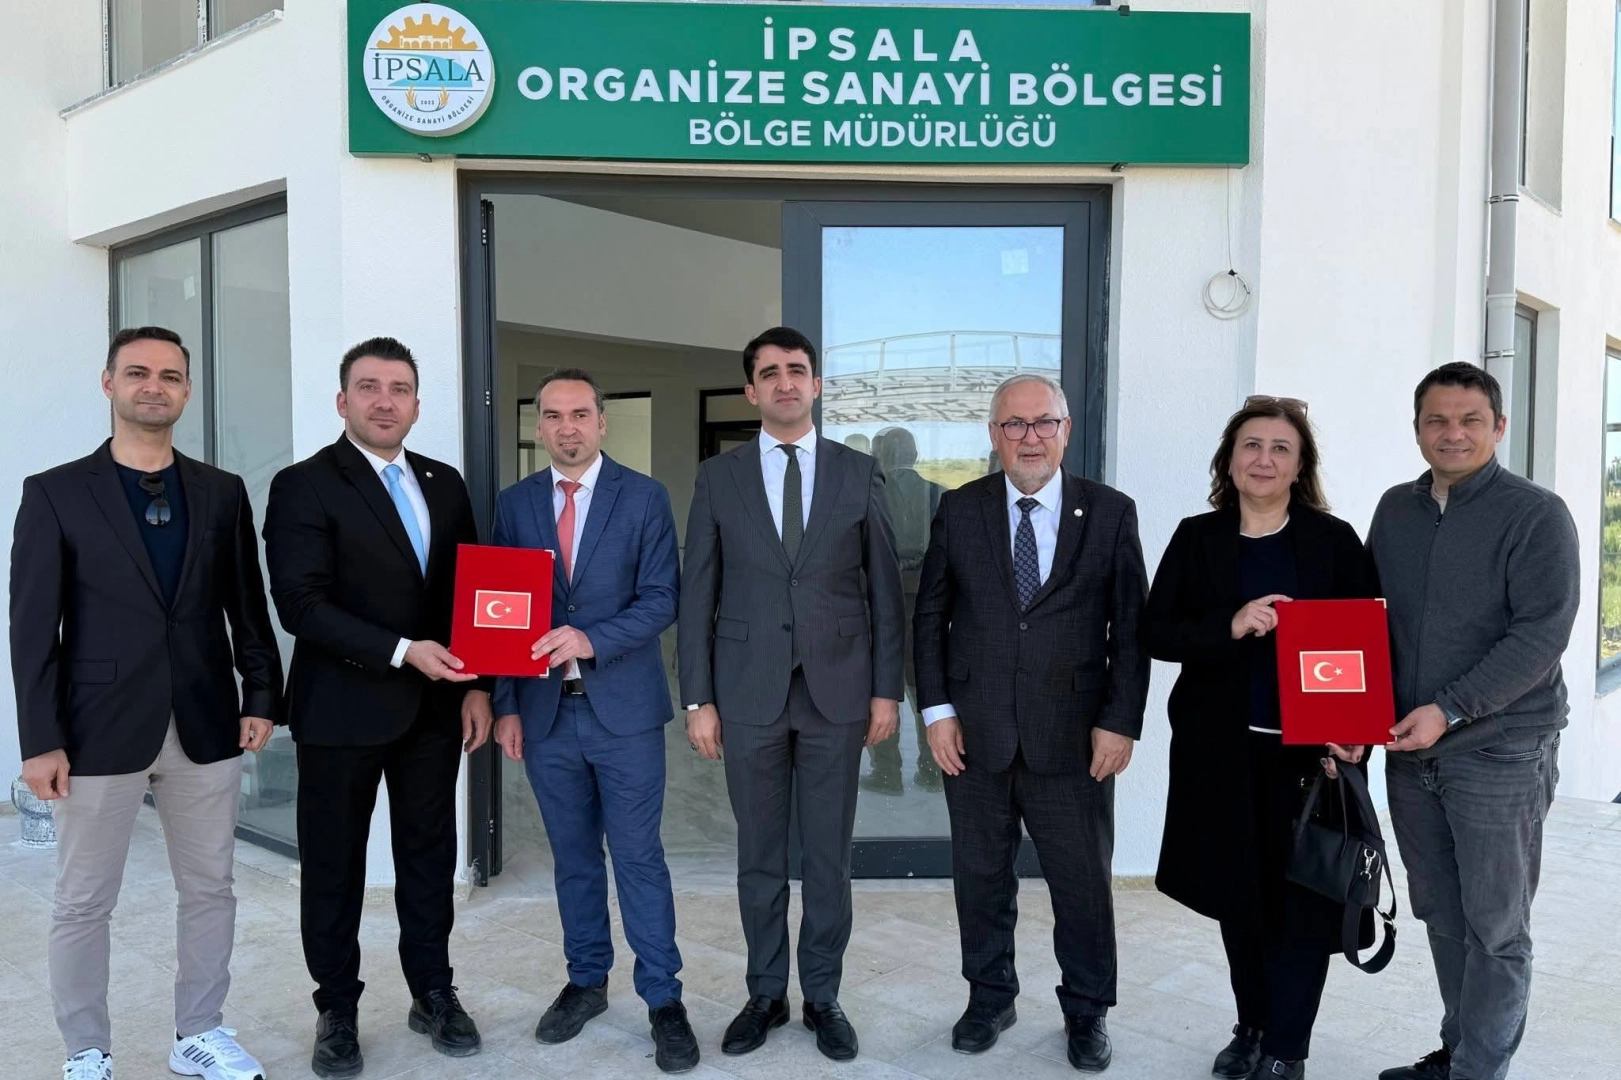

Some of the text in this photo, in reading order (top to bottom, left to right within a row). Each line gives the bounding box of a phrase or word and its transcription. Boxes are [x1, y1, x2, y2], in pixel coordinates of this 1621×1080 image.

[764, 16, 982, 61] İPSALA
[372, 52, 485, 82] İPSALA
[517, 59, 1222, 107] ORGANİZE SANAYİ BÖLGESİ
[381, 95, 475, 124] ORGANİZE SANAYİ BÖLGESİ
[689, 111, 1056, 148] BÖLGE MÜDÜRLÜĞÜ
